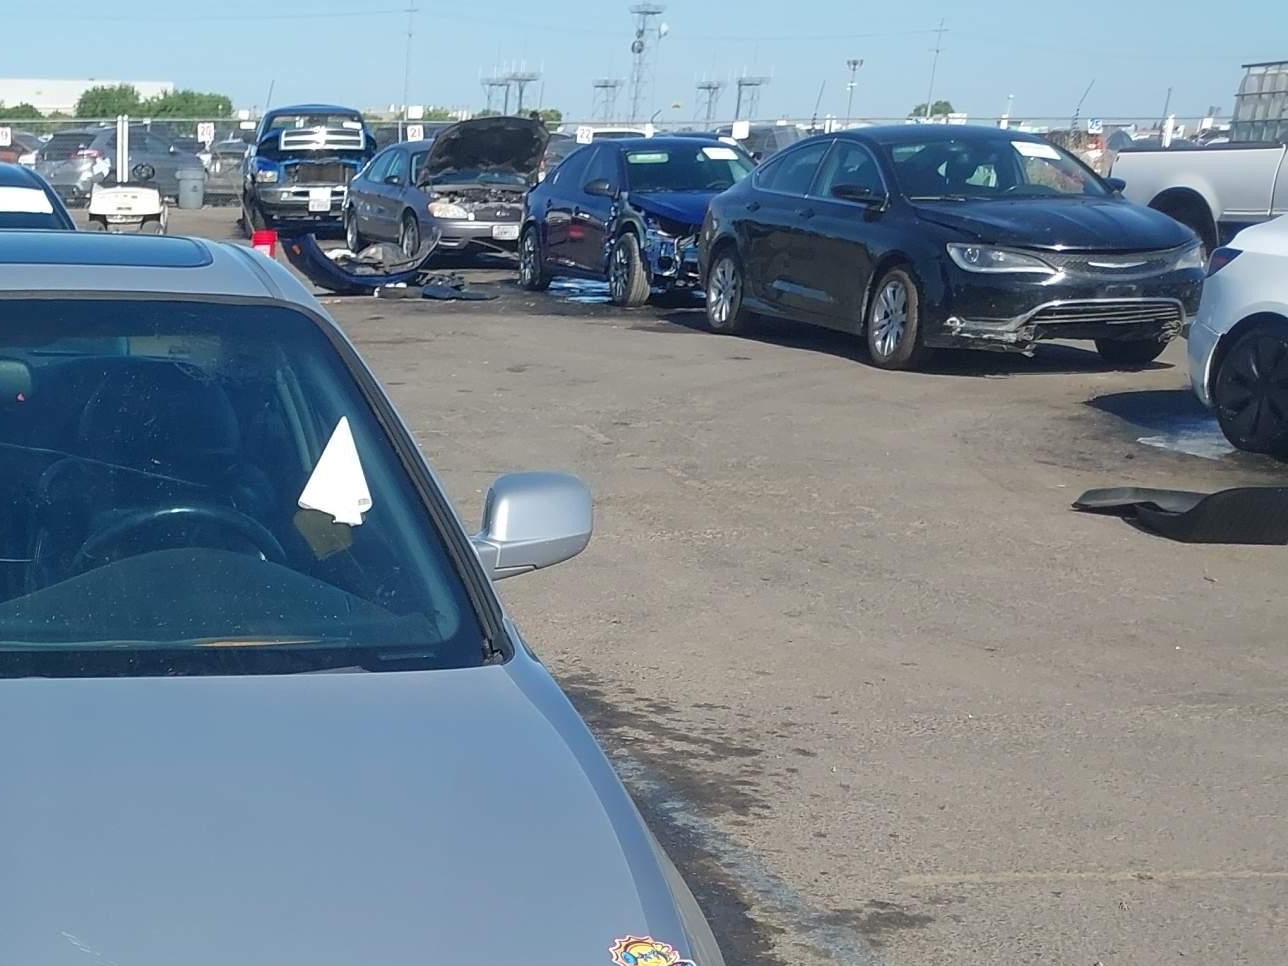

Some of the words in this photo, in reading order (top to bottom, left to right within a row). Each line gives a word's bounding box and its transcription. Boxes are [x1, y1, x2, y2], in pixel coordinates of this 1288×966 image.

[1089, 118, 1101, 131] 25
[409, 127, 421, 138] 21
[579, 128, 591, 139] 22
